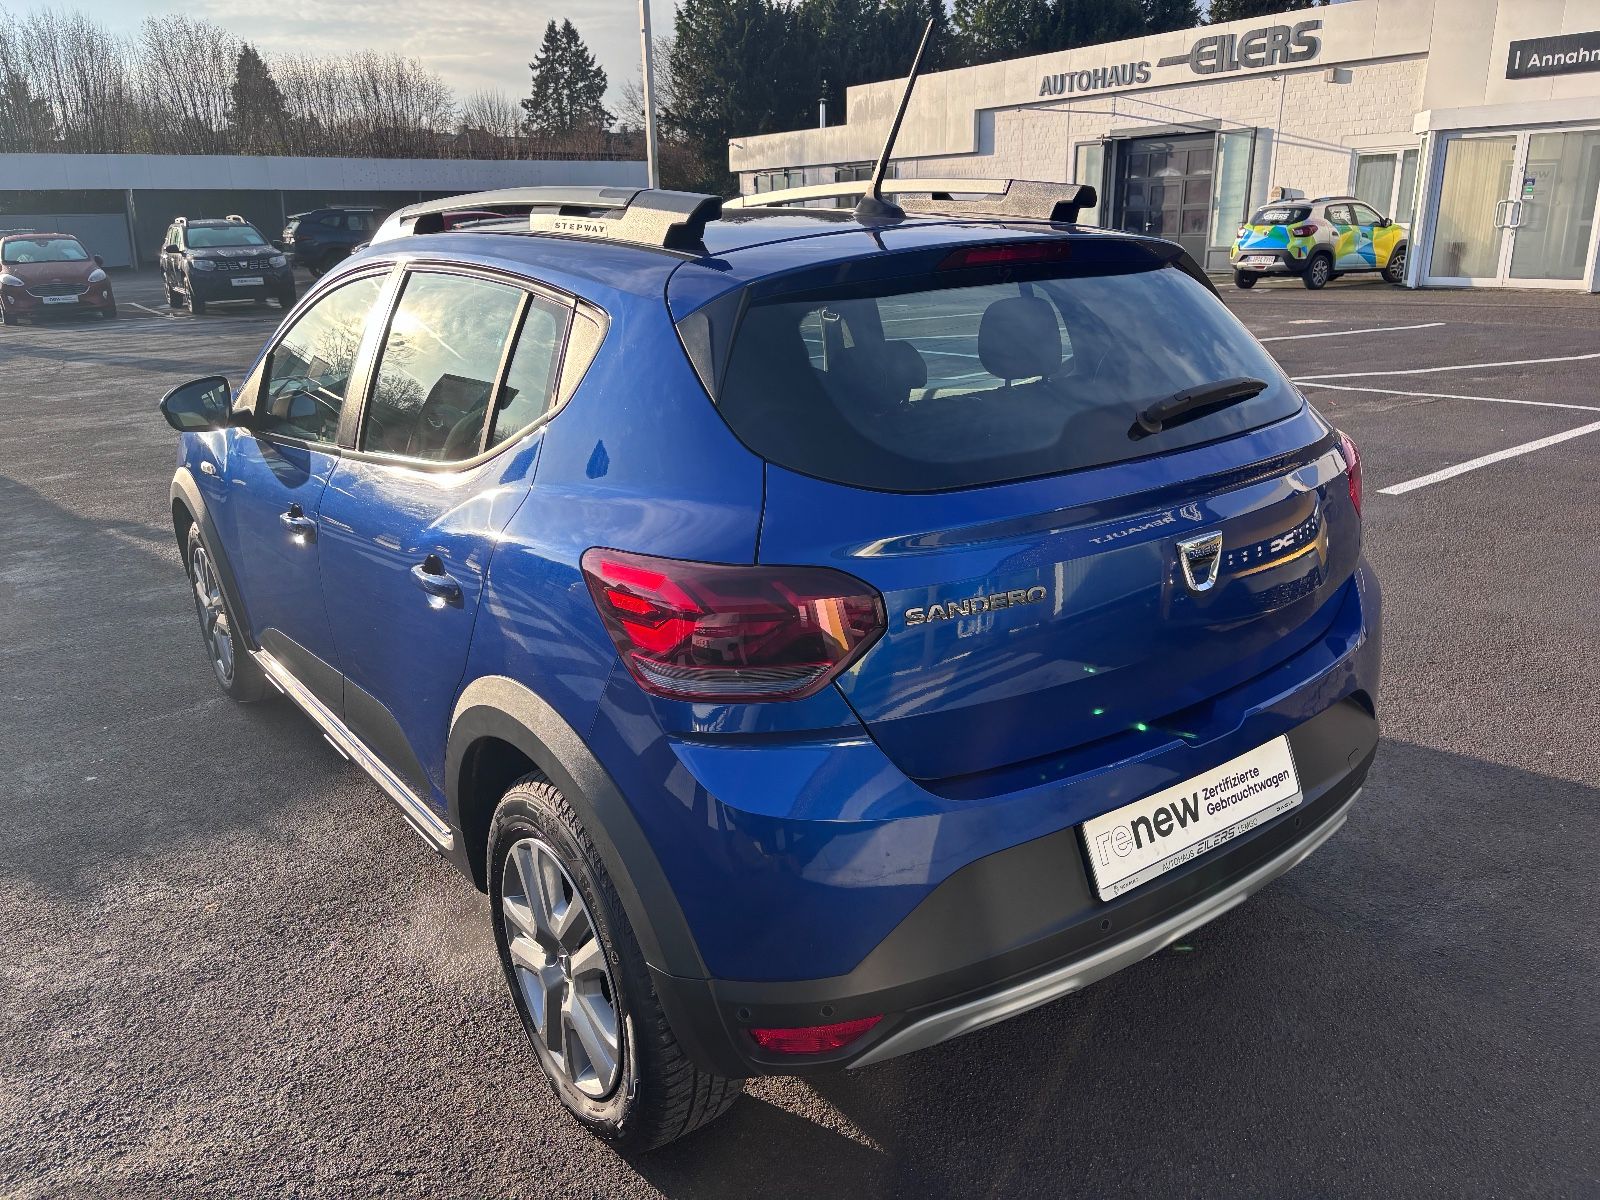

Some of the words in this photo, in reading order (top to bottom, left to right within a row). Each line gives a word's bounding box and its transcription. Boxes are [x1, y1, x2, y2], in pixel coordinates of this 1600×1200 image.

[1039, 61, 1151, 96] AUTOHAUS
[1190, 20, 1322, 75] EILERS
[554, 222, 605, 233] STEPWAY
[905, 585, 1047, 626] SANDERO
[1202, 767, 1260, 801] Zertifizierte
[1207, 770, 1290, 816] Gebrauchtwagen
[1095, 791, 1200, 867] renew
[1162, 849, 1195, 872] AUTOHAUS
[1196, 826, 1235, 855] EILERS
